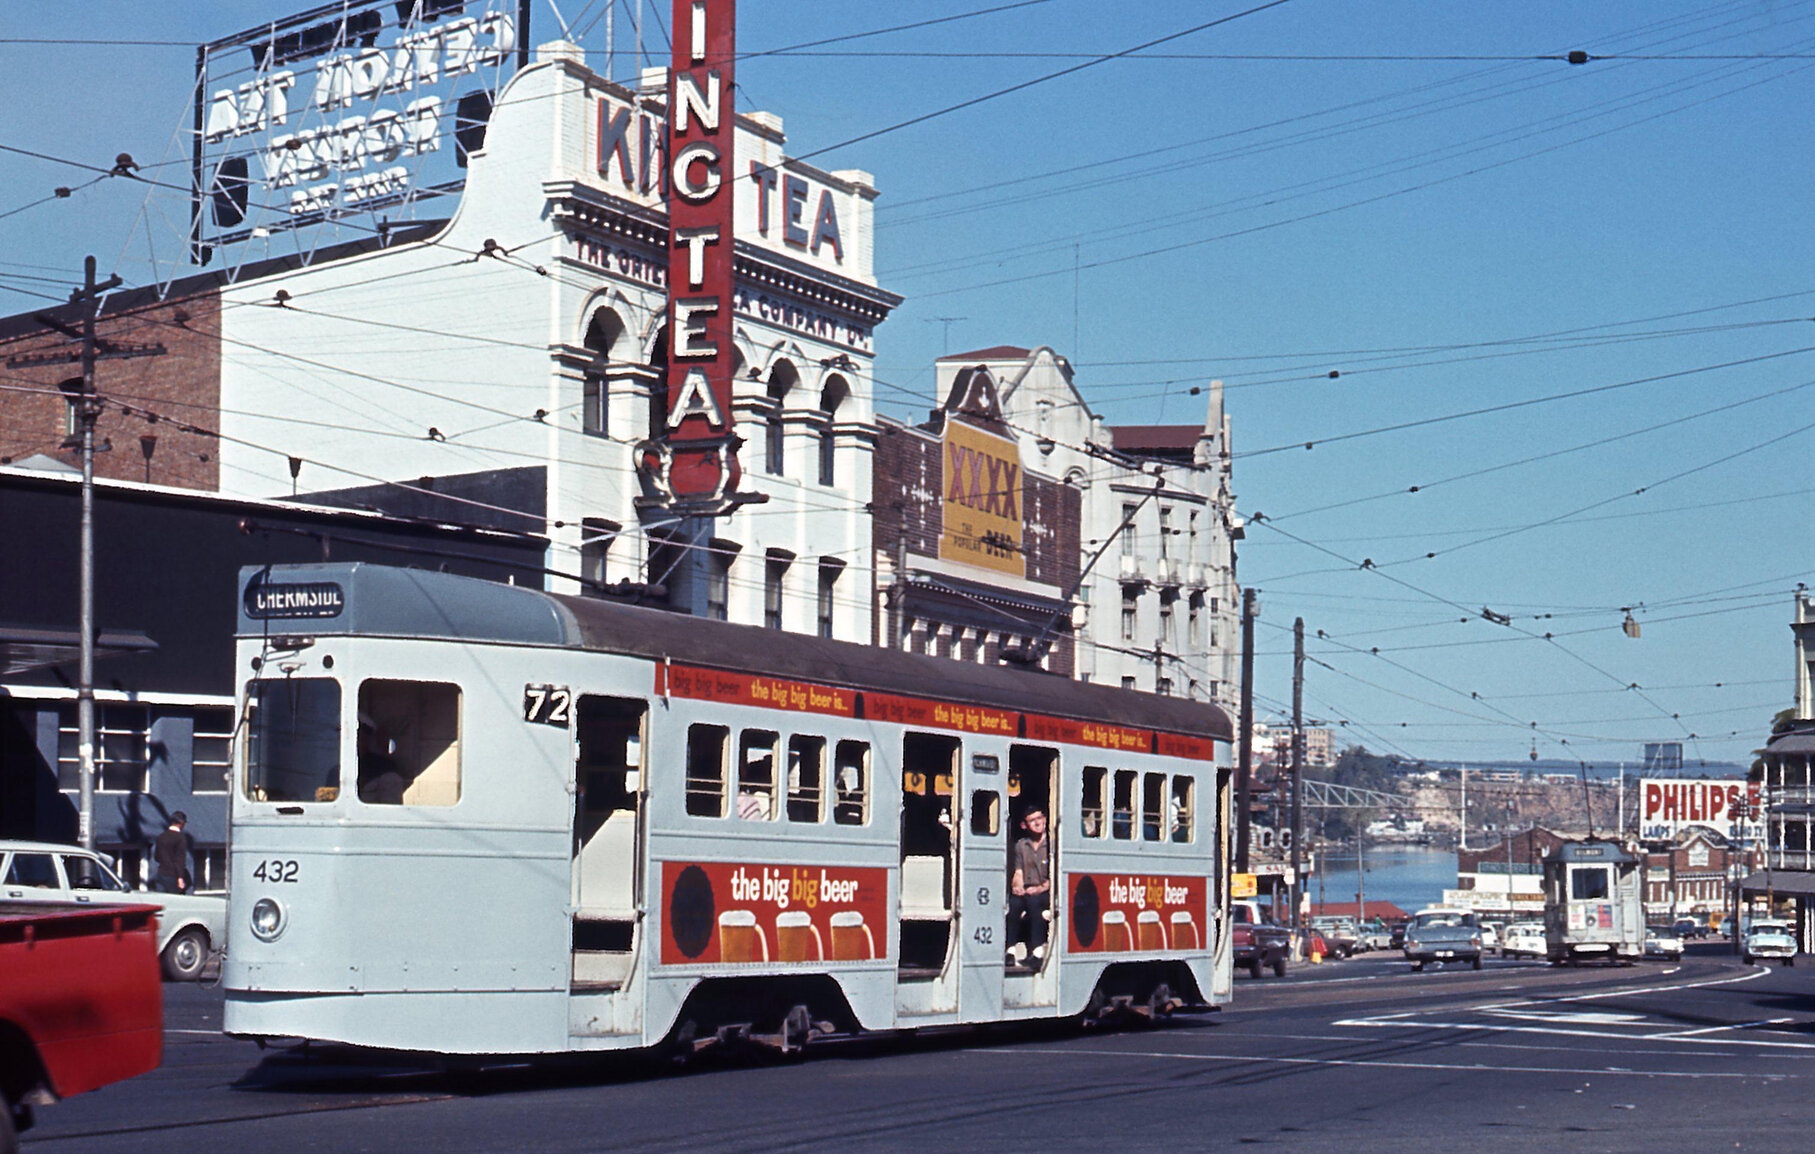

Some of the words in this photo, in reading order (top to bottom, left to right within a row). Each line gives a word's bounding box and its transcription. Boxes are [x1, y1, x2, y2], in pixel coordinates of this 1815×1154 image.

[750, 160, 844, 260] TEA
[574, 237, 612, 270] THE
[668, 229, 721, 427] TEA
[758, 296, 838, 341] COMPANY
[948, 441, 1018, 521] XXXX
[674, 669, 691, 695] big
[696, 673, 712, 698] big
[716, 675, 741, 695] beer
[751, 679, 769, 699] the
[772, 682, 788, 707] big
[791, 685, 807, 710] big
[810, 687, 832, 708] beer
[527, 690, 569, 721] 72
[934, 704, 948, 722] the
[951, 706, 964, 729] big
[966, 708, 979, 731] big
[981, 710, 999, 728] beer
[1082, 725, 1095, 742] the
[1096, 724, 1108, 747] big
[1108, 728, 1120, 748] big
[1121, 730, 1136, 746] beer
[1646, 784, 1740, 821] PHILIPS
[253, 860, 299, 883] 432
[731, 867, 760, 901] the
[763, 868, 790, 909] big
[792, 868, 818, 909] big
[820, 869, 858, 902] beer
[1109, 877, 1128, 903] the
[1129, 877, 1146, 909] big
[1147, 877, 1163, 909] big
[1164, 878, 1188, 904] beer
[973, 926, 993, 945] 432
